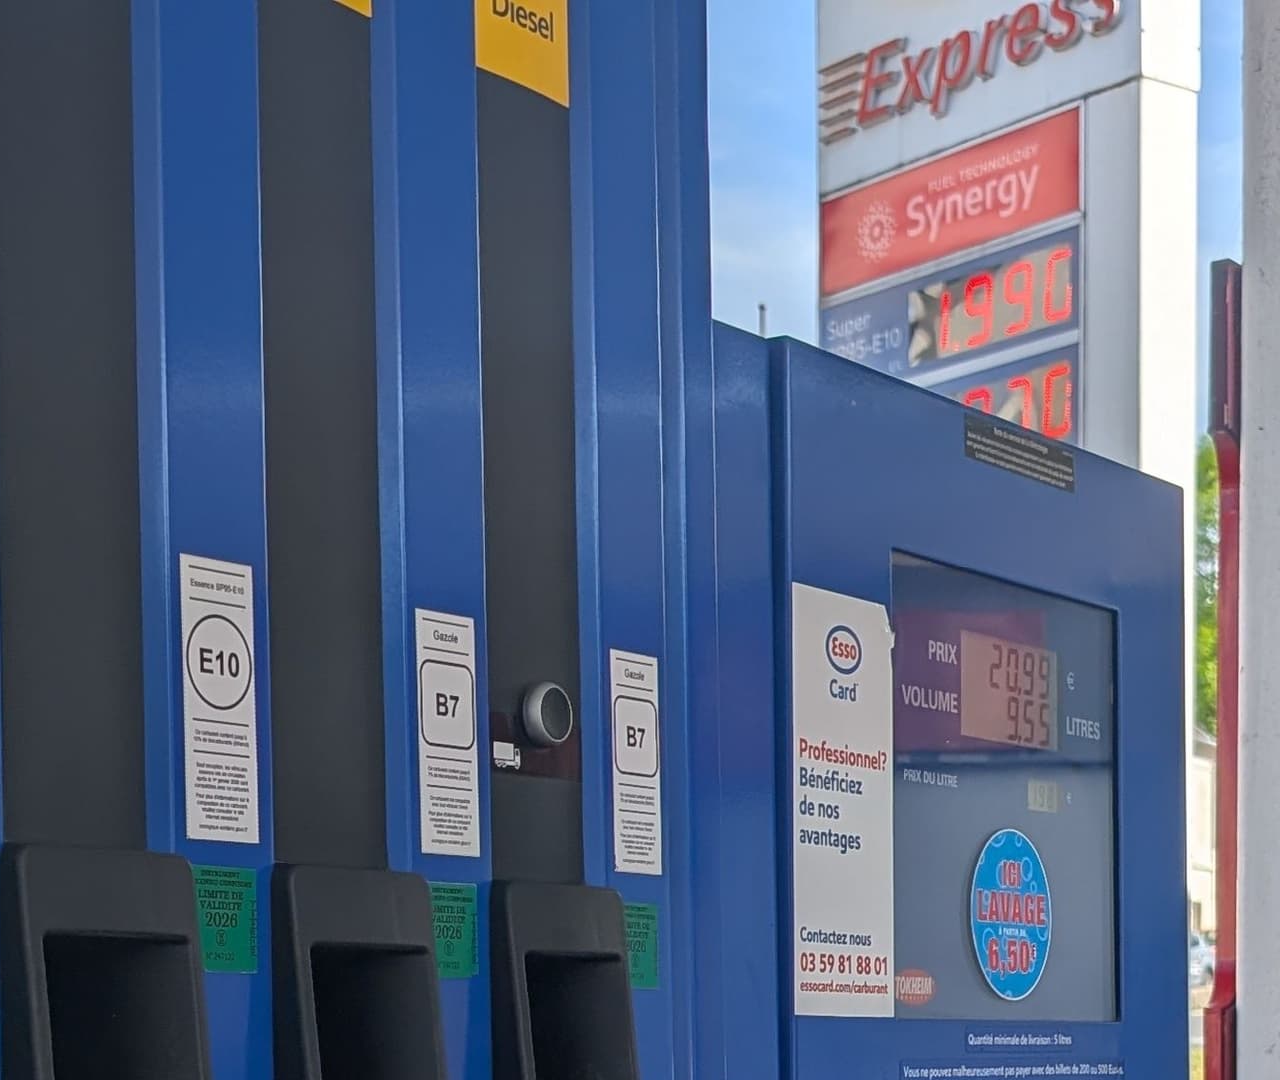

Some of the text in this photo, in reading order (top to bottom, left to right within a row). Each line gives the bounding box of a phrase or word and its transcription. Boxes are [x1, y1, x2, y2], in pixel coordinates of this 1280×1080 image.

[491, 0, 554, 42] Diesel
[857, 0, 1120, 125] Express
[959, 144, 1040, 181] TECHNOLOGY
[906, 164, 1041, 244] Synergy
[826, 313, 872, 340] Super
[190, 577, 214, 590] Essence
[433, 629, 458, 644] Gazole
[831, 635, 858, 661] Esso
[199, 647, 240, 678] E10
[927, 639, 958, 665] PRIX
[624, 668, 645, 681] Gazole
[1066, 671, 1075, 690] €
[436, 692, 460, 718] B7
[901, 683, 959, 713] VOLUME
[626, 725, 645, 748] B7
[1066, 715, 1101, 740] LITRES
[799, 766, 863, 796] Bénéficiez
[903, 768, 959, 788] PRIX DU LITRE
[799, 794, 840, 820] de nos
[799, 827, 861, 855] avantages
[1001, 860, 1023, 889] ICI
[976, 887, 1048, 927] LAVAGE
[205, 911, 238, 929] 2026
[435, 924, 463, 940] 2026
[800, 926, 872, 946] Contactez nous
[800, 952, 888, 976] 03 59 81 88 01
[800, 980, 888, 994] essocard.com/carburant
[895, 975, 933, 995] TOKHEIM
[968, 1033, 993, 1045] Quantité
[1020, 1034, 1028, 1045] de
[903, 1065, 919, 1078] Vous
[920, 1068, 929, 1077] ne
[929, 1068, 952, 1080] pouvez
[952, 1064, 1004, 1077] malheureusement
[1004, 1067, 1015, 1078] pas
[1045, 1064, 1055, 1075] des
[1071, 1064, 1079, 1075] de
